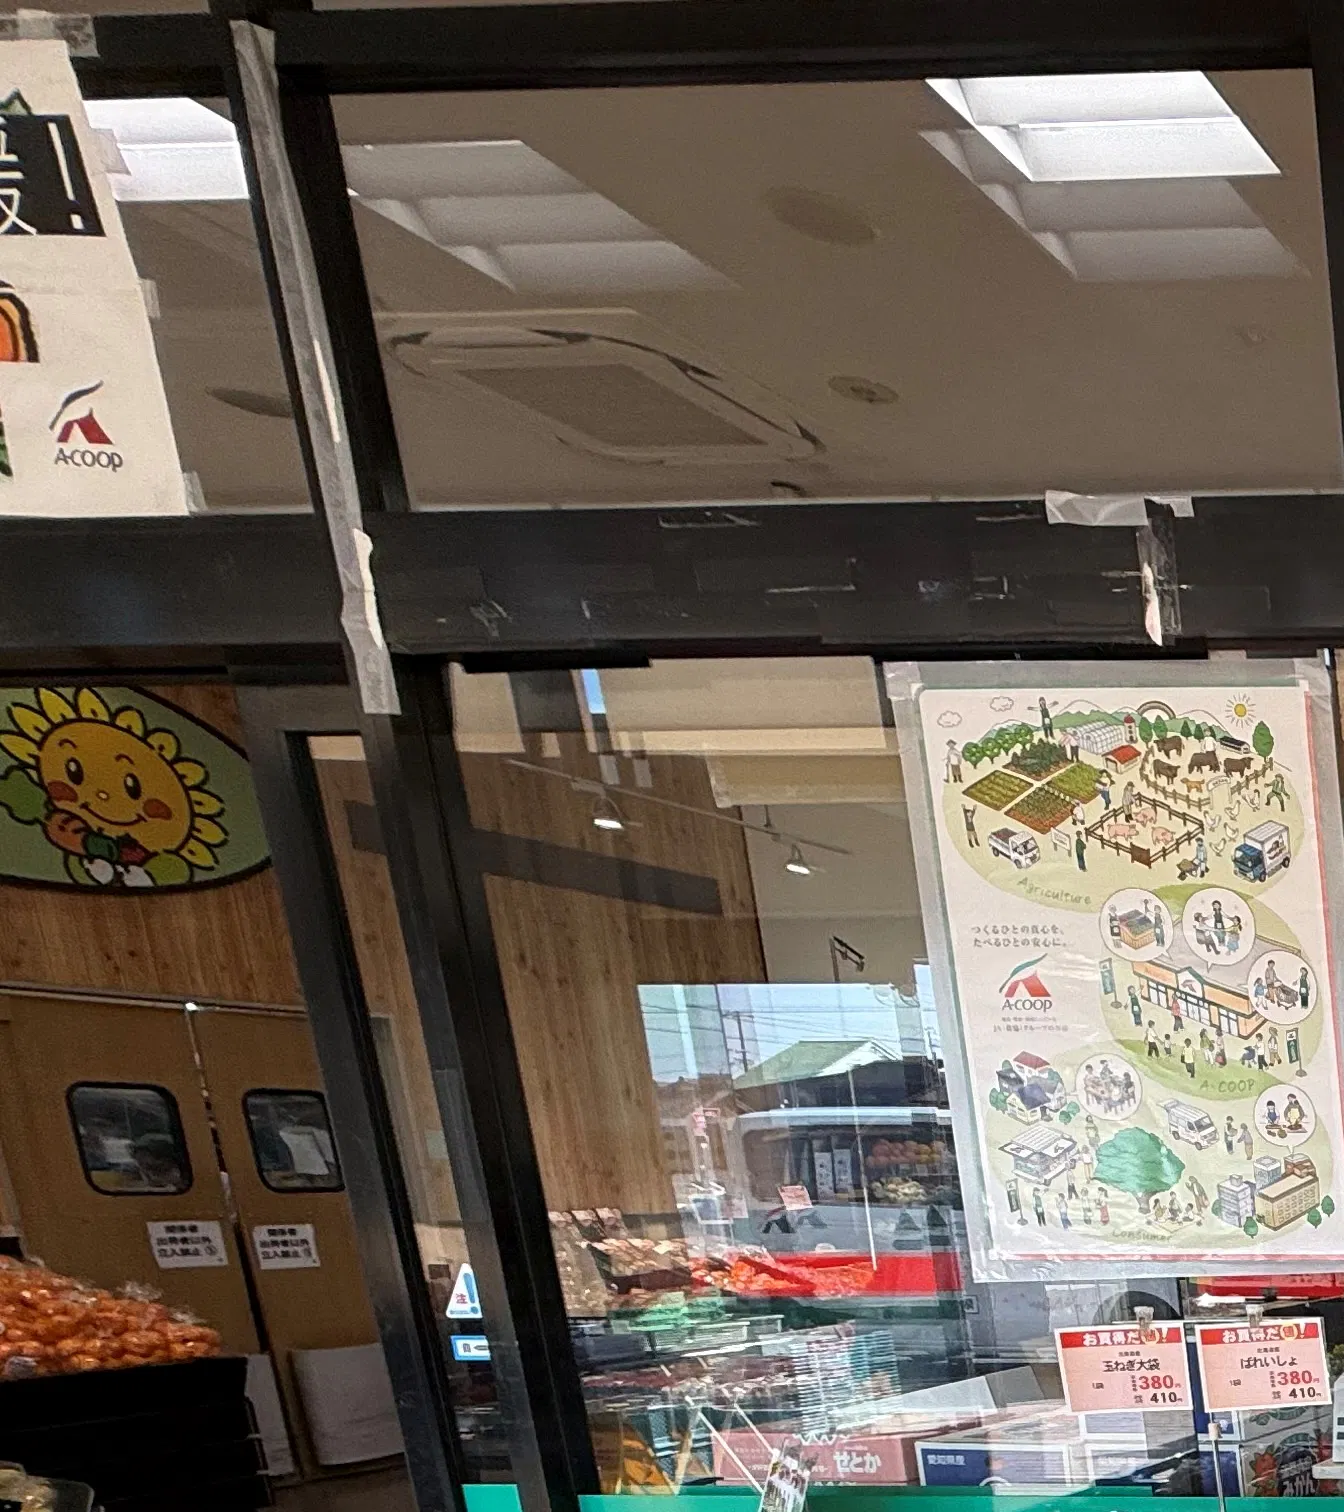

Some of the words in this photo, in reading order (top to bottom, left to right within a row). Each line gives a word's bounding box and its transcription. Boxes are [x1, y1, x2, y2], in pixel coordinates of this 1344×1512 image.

[54, 448, 123, 472] A-COOP
[1017, 876, 1092, 904] Agriculture
[1001, 999, 1053, 1012] A-COOP
[1102, 1358, 1161, 1373] 玉ねぎ大袋
[1240, 1355, 1298, 1369] ばれいしょ
[1139, 1375, 1181, 1390] 380円
[1278, 1370, 1320, 1386] 380円
[832, 1451, 882, 1474] せとか
[926, 1453, 966, 1466] 愛知県産
